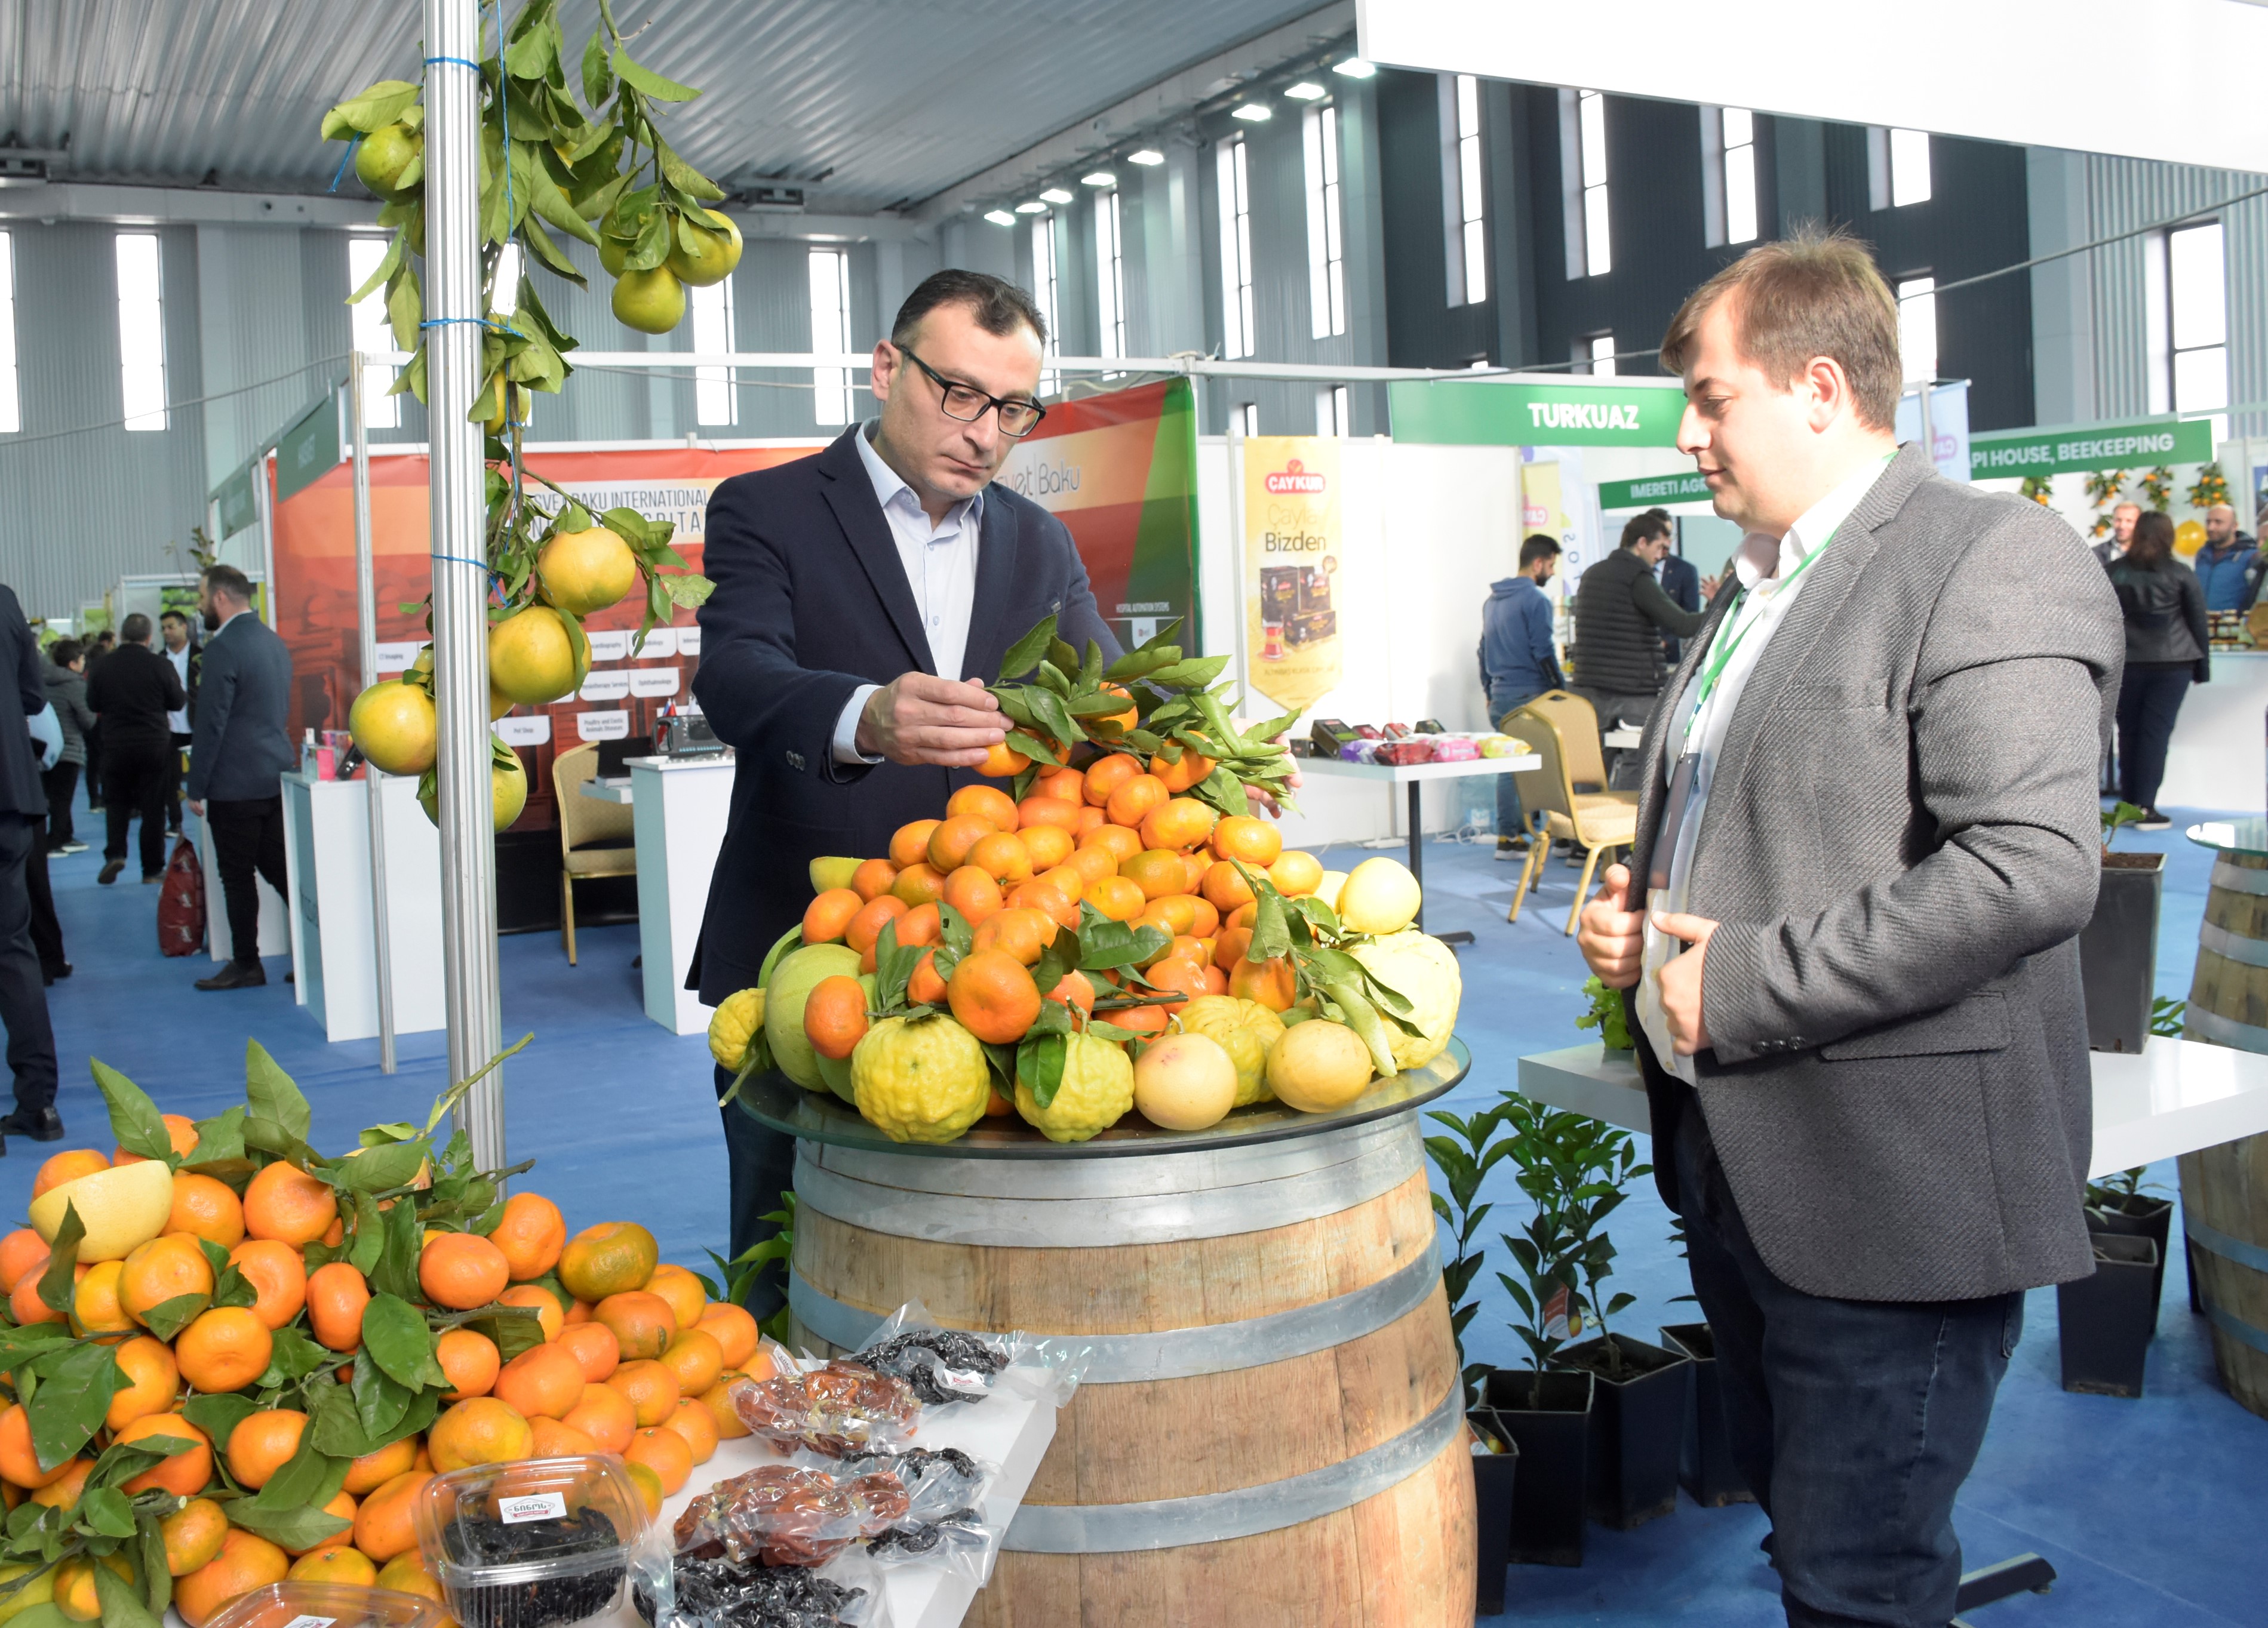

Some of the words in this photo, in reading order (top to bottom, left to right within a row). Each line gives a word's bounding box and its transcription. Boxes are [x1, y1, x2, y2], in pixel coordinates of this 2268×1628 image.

[1527, 402, 1640, 430] TURKUAZ
[1971, 451, 1989, 469] PI
[1990, 445, 2055, 467] HOUSE,
[2057, 433, 2174, 461] BEEKEEPING
[1038, 458, 1080, 495] Baku
[1268, 476, 1324, 491] ÇAYKUR
[1630, 479, 1678, 498] IMERETI
[1679, 477, 1708, 494] AGR
[611, 488, 707, 509] INTERNATIONAL
[1265, 530, 1326, 552] Bizden
